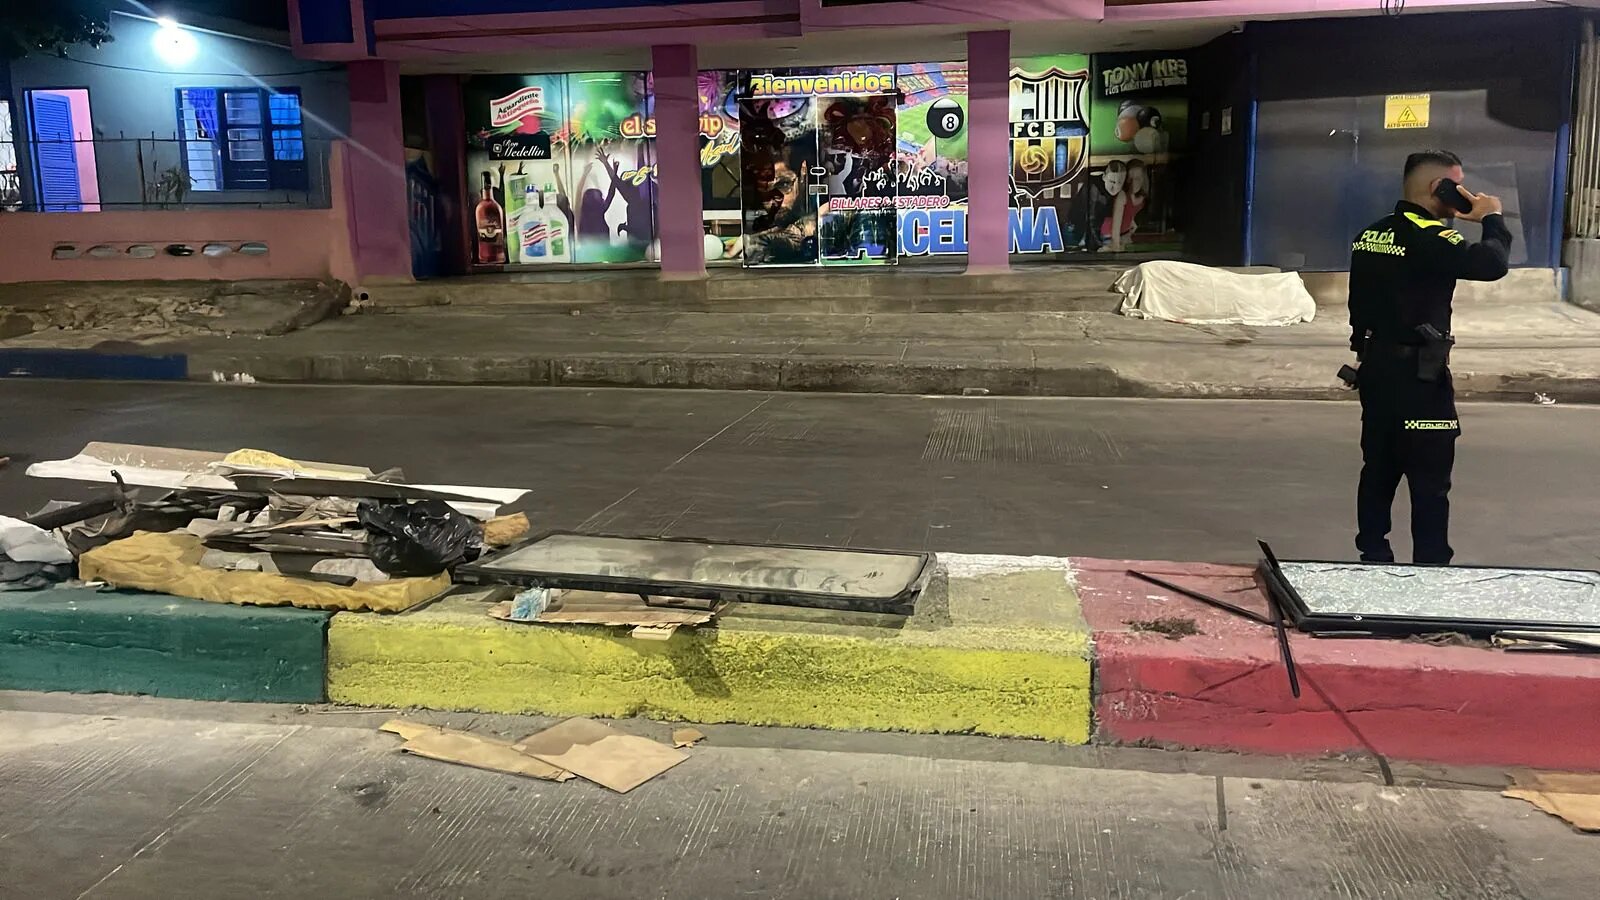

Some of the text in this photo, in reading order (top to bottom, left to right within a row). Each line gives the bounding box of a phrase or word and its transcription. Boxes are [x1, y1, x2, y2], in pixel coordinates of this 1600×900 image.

[750, 71, 893, 96] Bienvenidos
[1103, 61, 1149, 88] TONY
[498, 92, 540, 114] Aguardiente
[622, 115, 641, 134] el
[946, 116, 955, 130] 8
[1013, 121, 1056, 138] FCB
[830, 196, 880, 209] BILLARES
[893, 193, 949, 208] ESTADERO
